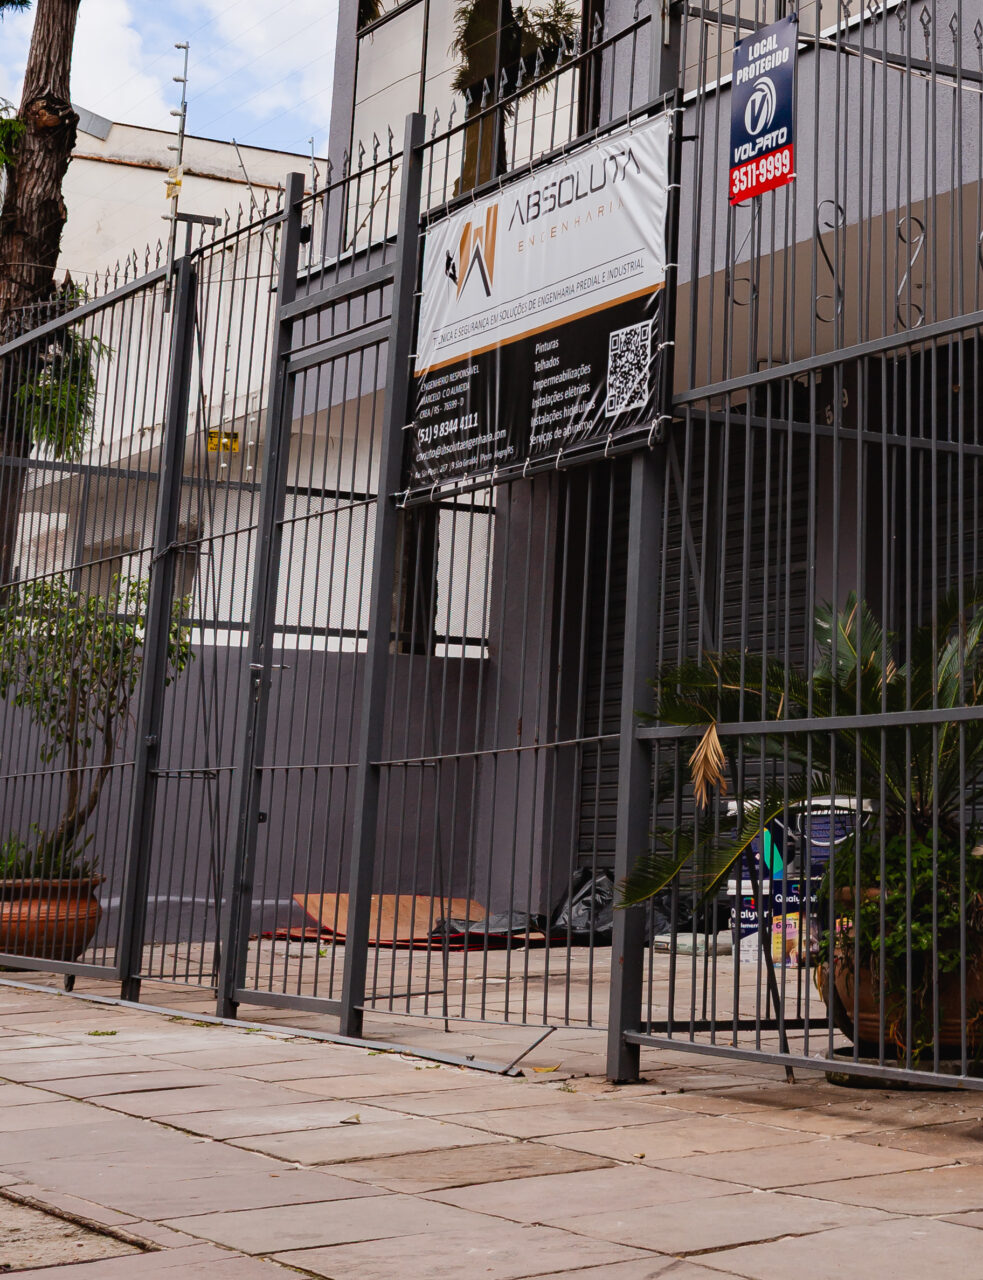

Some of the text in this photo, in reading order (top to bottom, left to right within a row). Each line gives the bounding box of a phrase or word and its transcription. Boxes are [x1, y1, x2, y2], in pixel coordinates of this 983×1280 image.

[748, 33, 777, 61] LOCAL
[736, 47, 789, 86] PROTEGIDO
[734, 126, 788, 164] VOLPATO
[732, 149, 790, 194] 3511-9999
[508, 147, 641, 231] ABSOLUTA
[499, 301, 528, 321] SOLUÇÕES
[537, 282, 575, 308] ENGENHARIA
[575, 273, 601, 293] PREDIAL
[607, 257, 644, 281] INDUSTRIAL
[535, 338, 559, 355] Pinturas
[533, 363, 591, 391] Impermeabilizações
[534, 355, 560, 373] Telhados
[532, 383, 591, 410] Instalações elétricas
[417, 425, 432, 446] (51)
[439, 418, 458, 437] 8344
[460, 412, 479, 430] 4111
